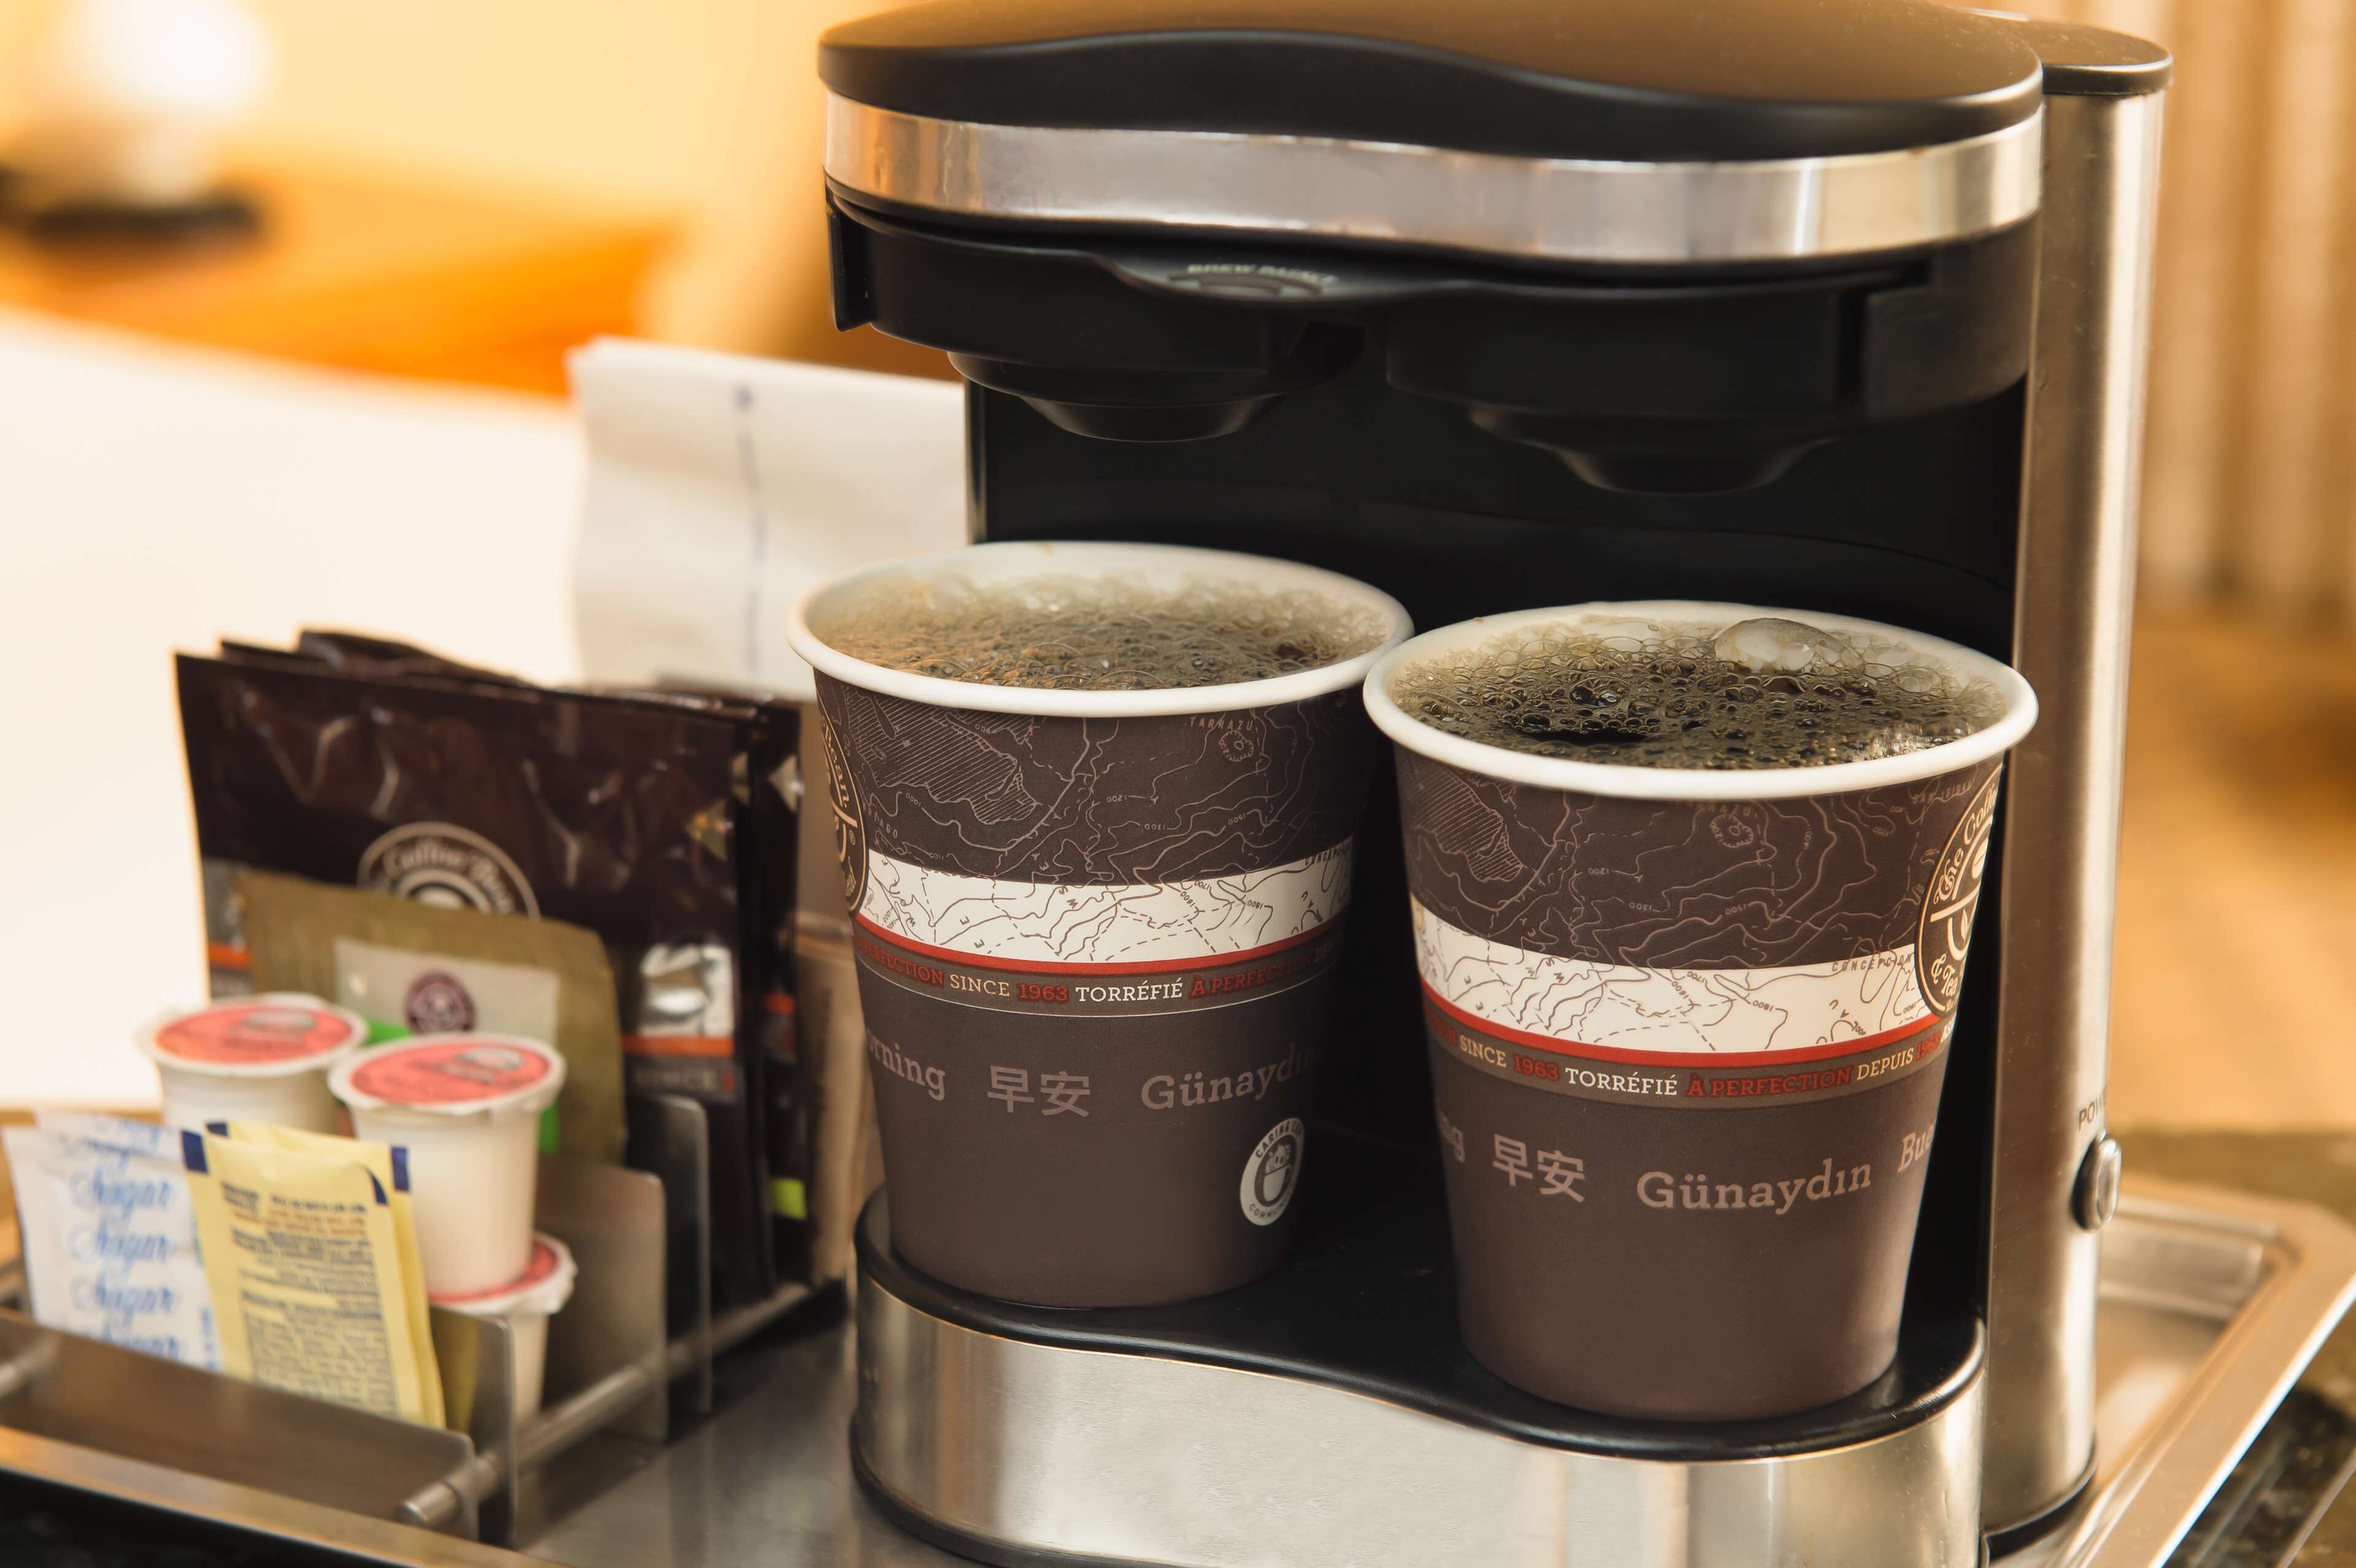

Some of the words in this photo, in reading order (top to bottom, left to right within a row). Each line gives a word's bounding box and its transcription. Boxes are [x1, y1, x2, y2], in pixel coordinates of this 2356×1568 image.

[950, 973, 1010, 997] SINCE
[1018, 983, 1069, 1002] 1963
[1075, 977, 1183, 1002] TORRÉFIÉ
[1191, 975, 1206, 996] À
[1210, 953, 1312, 994] PERFECTION
[869, 1035, 946, 1101] rning
[987, 1065, 1091, 1118] 早安
[1459, 1034, 1507, 1067] SINCE
[1513, 1054, 1561, 1082] 1963
[1566, 1071, 1678, 1096] TORRÉFIÉ
[1688, 1074, 1706, 1096] À
[1710, 1067, 1853, 1097] PERFECTION
[1856, 1047, 1915, 1081] DEPUIS
[1256, 1120, 1291, 1159] CARING
[1897, 1124, 1934, 1173] Bue
[1493, 1134, 1585, 1203] 早安
[1636, 1157, 1872, 1215] Günaydın
